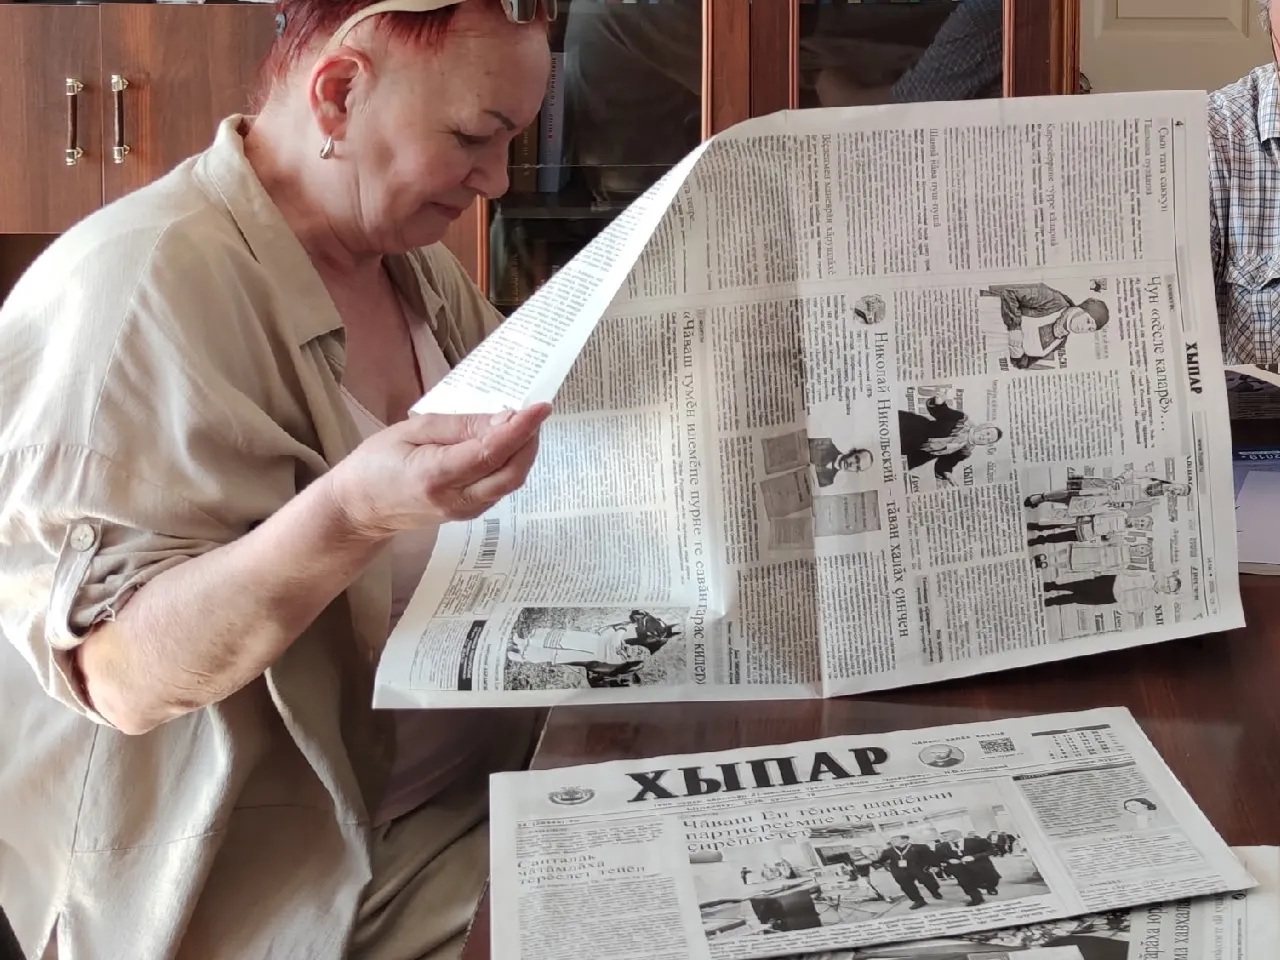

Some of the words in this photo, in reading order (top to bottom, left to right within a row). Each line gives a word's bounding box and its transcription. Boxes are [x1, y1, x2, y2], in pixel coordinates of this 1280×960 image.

[874, 331, 892, 394] Николай
[1184, 341, 1203, 395] ХЫПАР
[876, 398, 899, 484] Никольский
[626, 746, 891, 804] ХЫПАР
